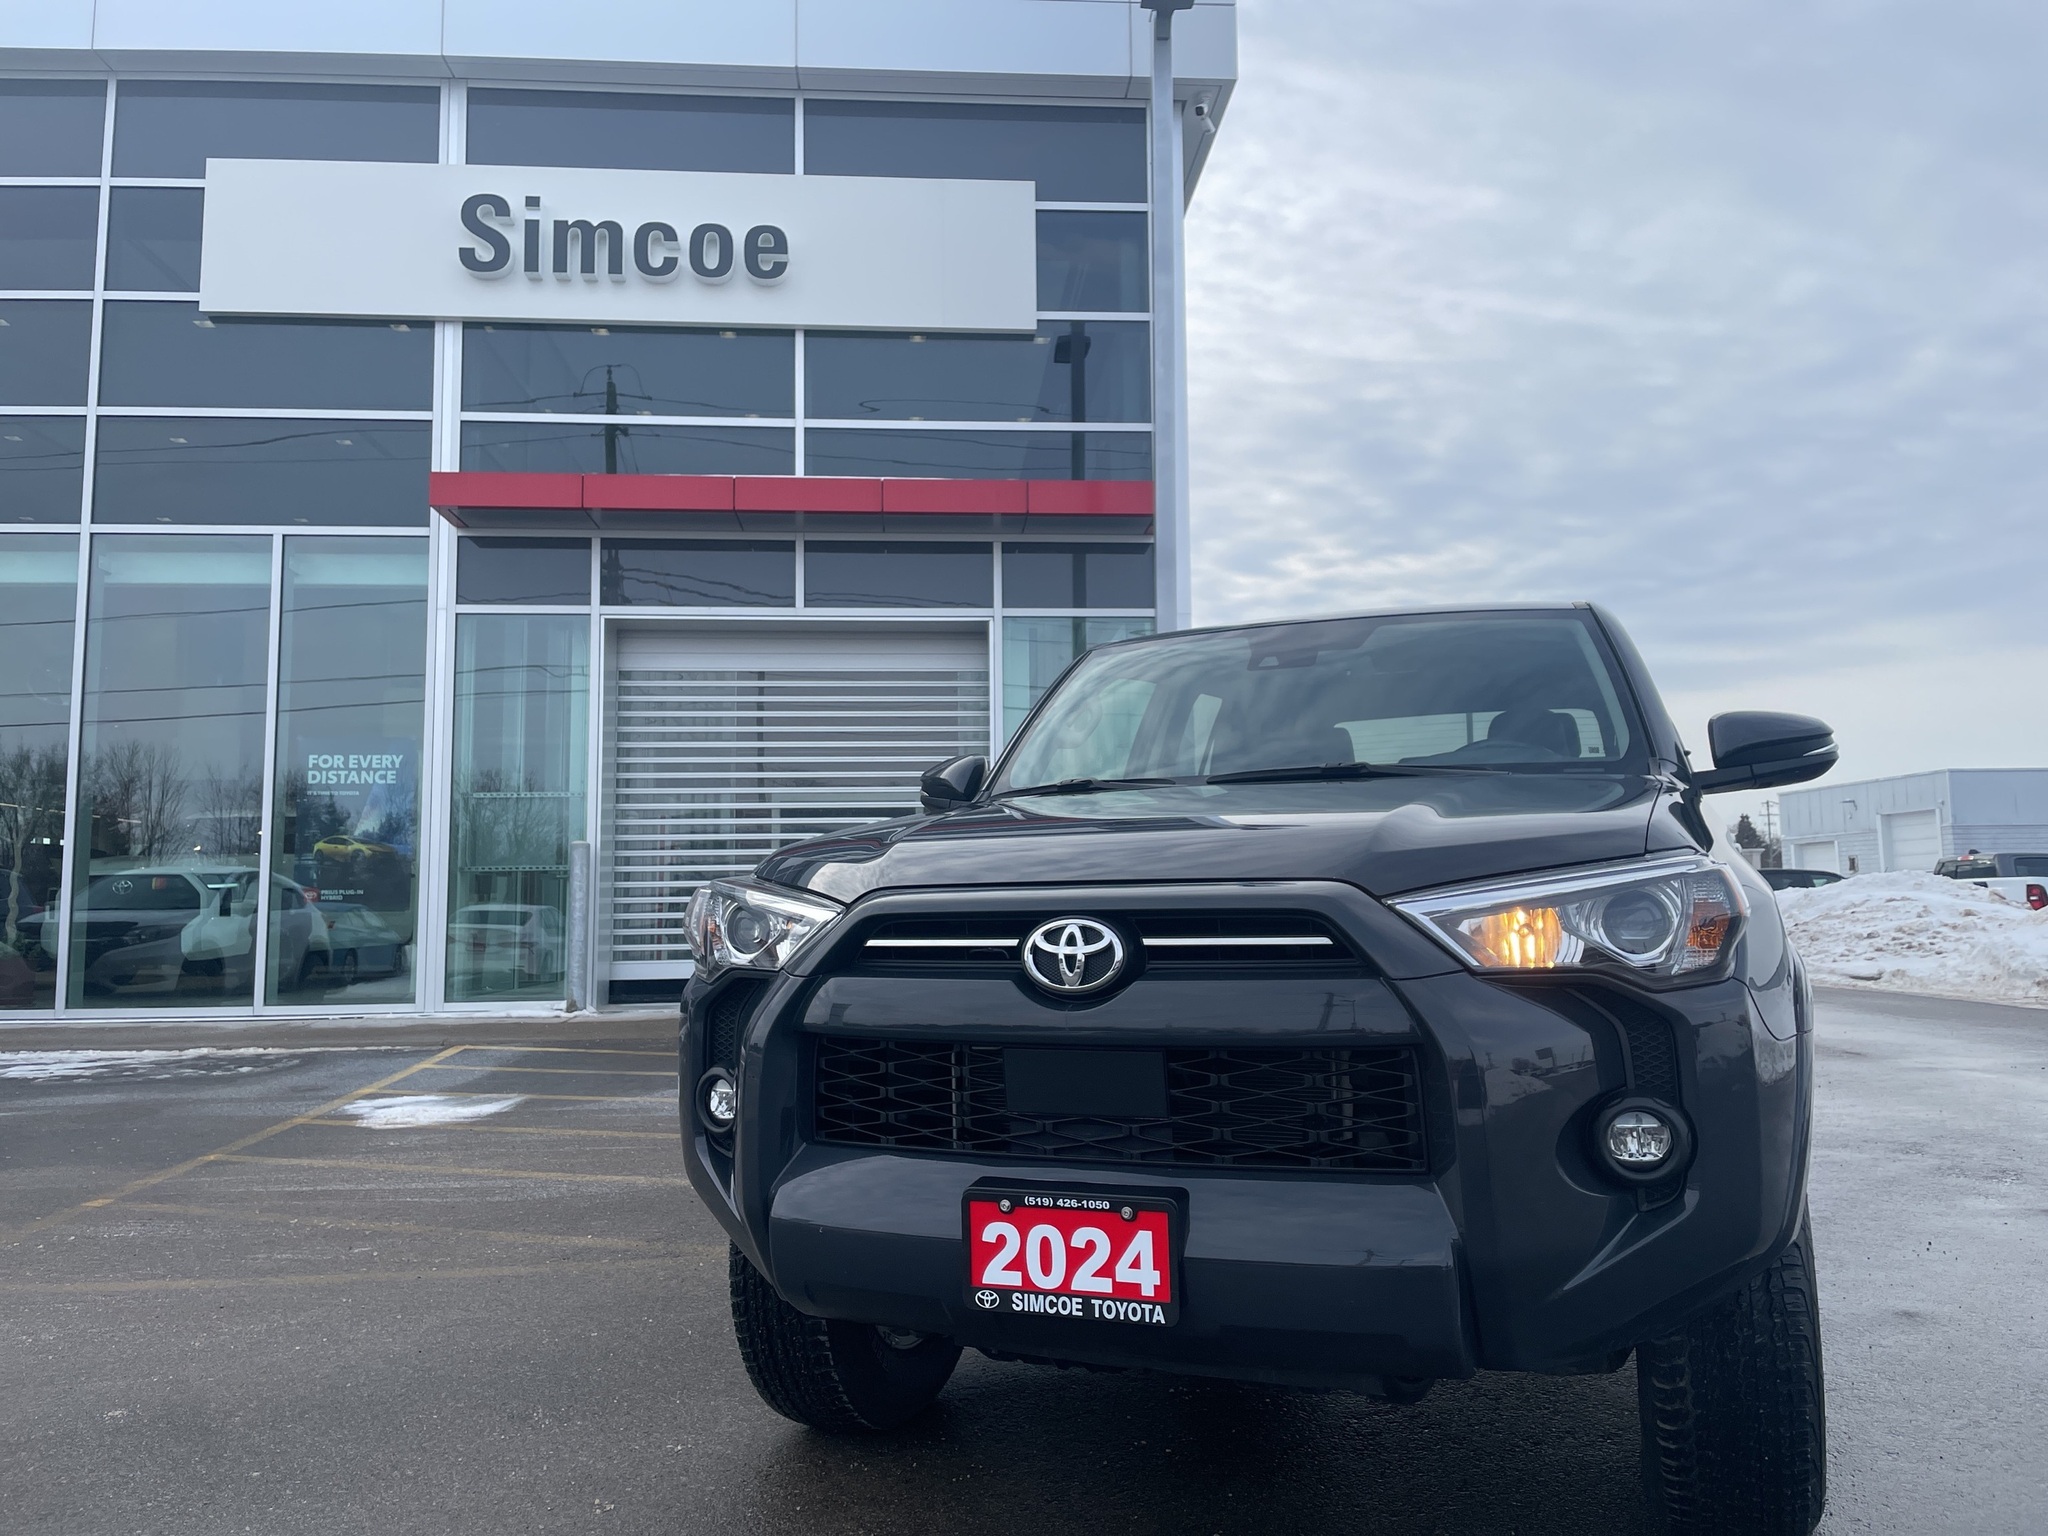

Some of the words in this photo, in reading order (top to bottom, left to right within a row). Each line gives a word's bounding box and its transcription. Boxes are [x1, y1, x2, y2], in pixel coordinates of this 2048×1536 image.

[459, 193, 789, 281] Simcoe
[308, 754, 345, 769] FOR
[348, 754, 403, 769] EVERY
[307, 770, 397, 785] DISTANCE
[1024, 1196, 1053, 1207] (519)
[1056, 1198, 1110, 1210] 426-1050
[981, 1221, 1161, 1297] 2024
[1012, 1292, 1083, 1316] SIMCOE
[1091, 1299, 1166, 1324] TOYOTA
